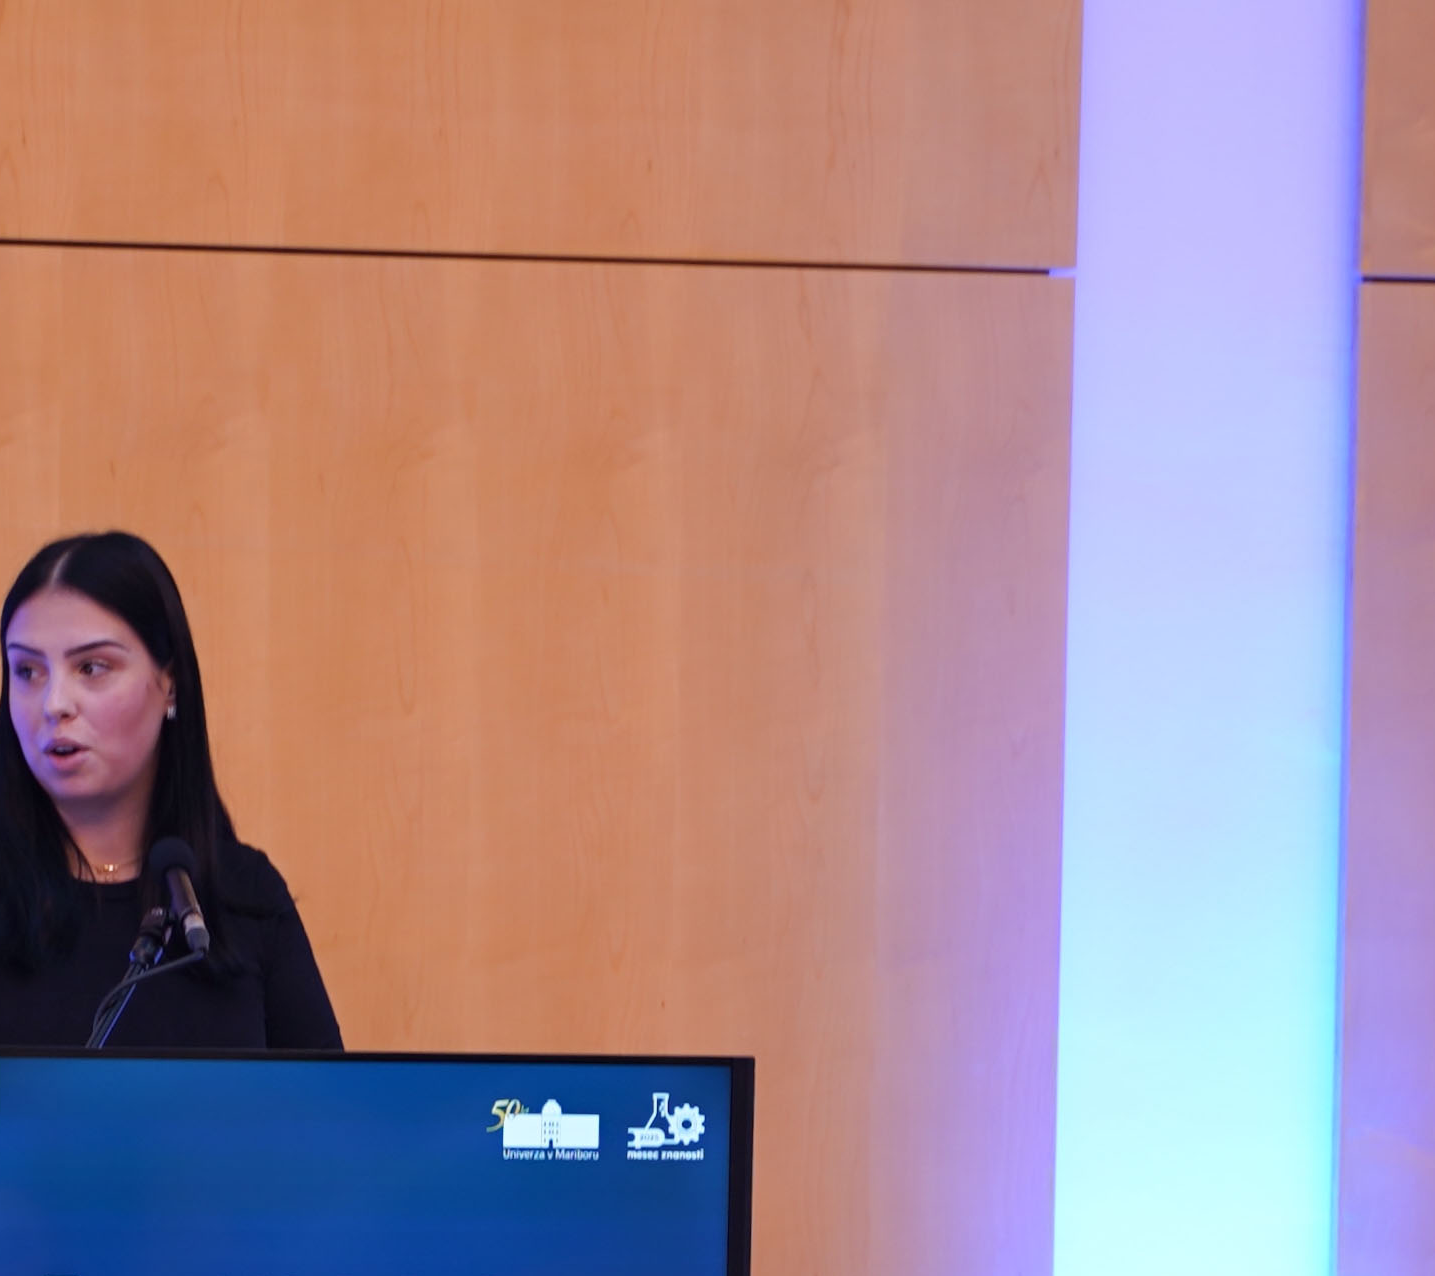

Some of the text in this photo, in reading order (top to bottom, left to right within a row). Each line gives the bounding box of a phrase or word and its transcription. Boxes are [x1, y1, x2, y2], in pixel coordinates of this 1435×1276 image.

[503, 1148, 599, 1161] Univerza v Mariboru
[627, 1148, 704, 1161] mesec znanosti
